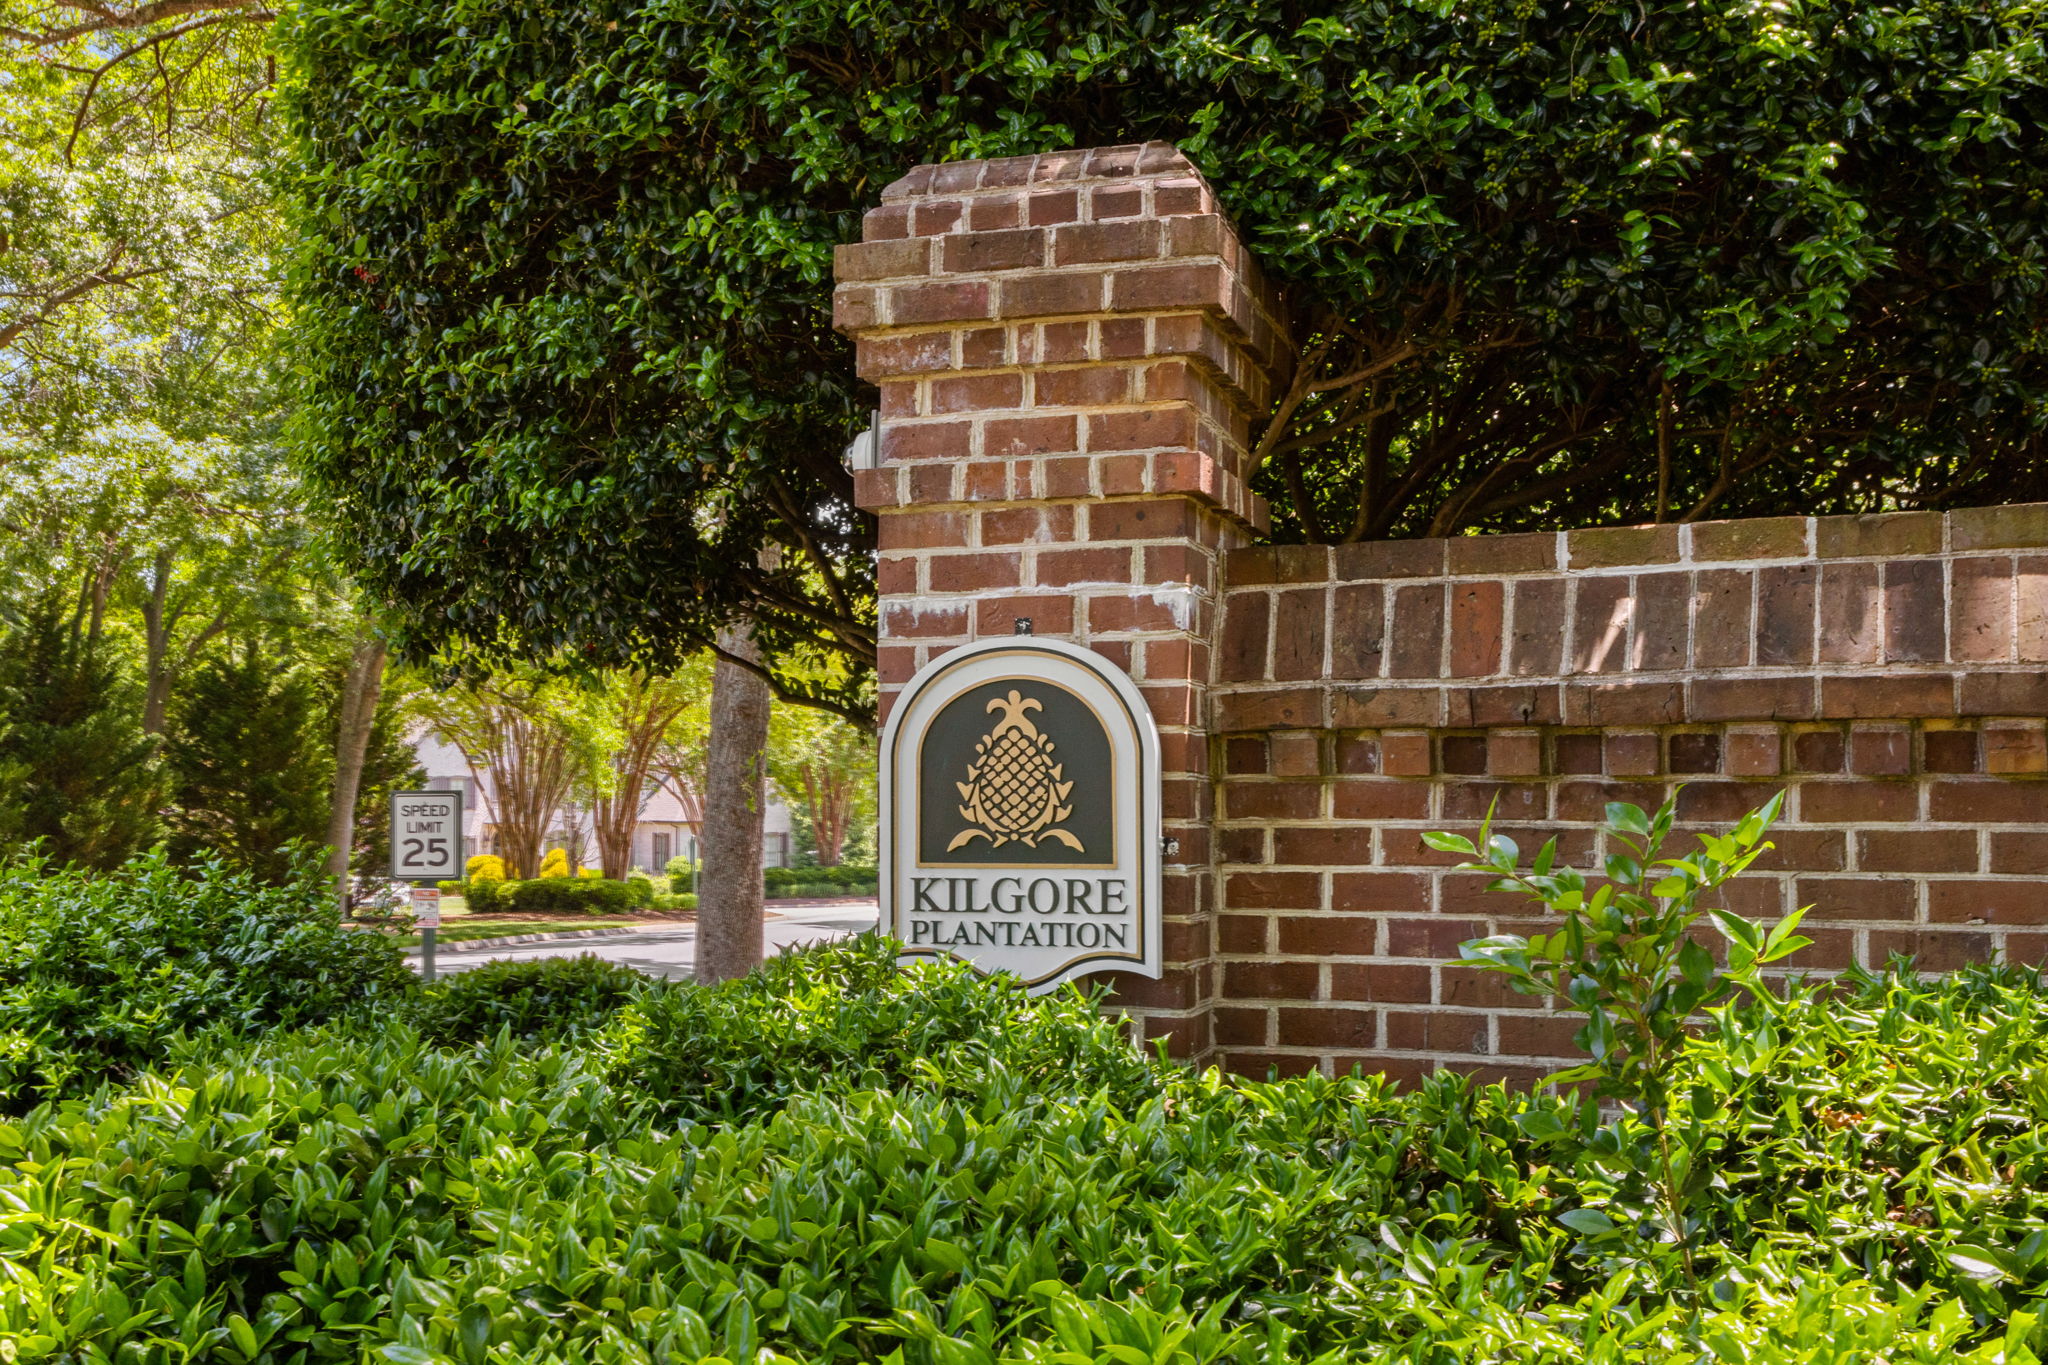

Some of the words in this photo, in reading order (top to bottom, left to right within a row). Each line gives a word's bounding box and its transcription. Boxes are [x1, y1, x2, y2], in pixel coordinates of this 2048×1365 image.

[401, 805, 450, 817] SPEED
[406, 822, 443, 833] LIMIT
[402, 838, 449, 867] 25
[910, 877, 1128, 915] KILGORE
[910, 920, 1128, 948] PLANTATION
